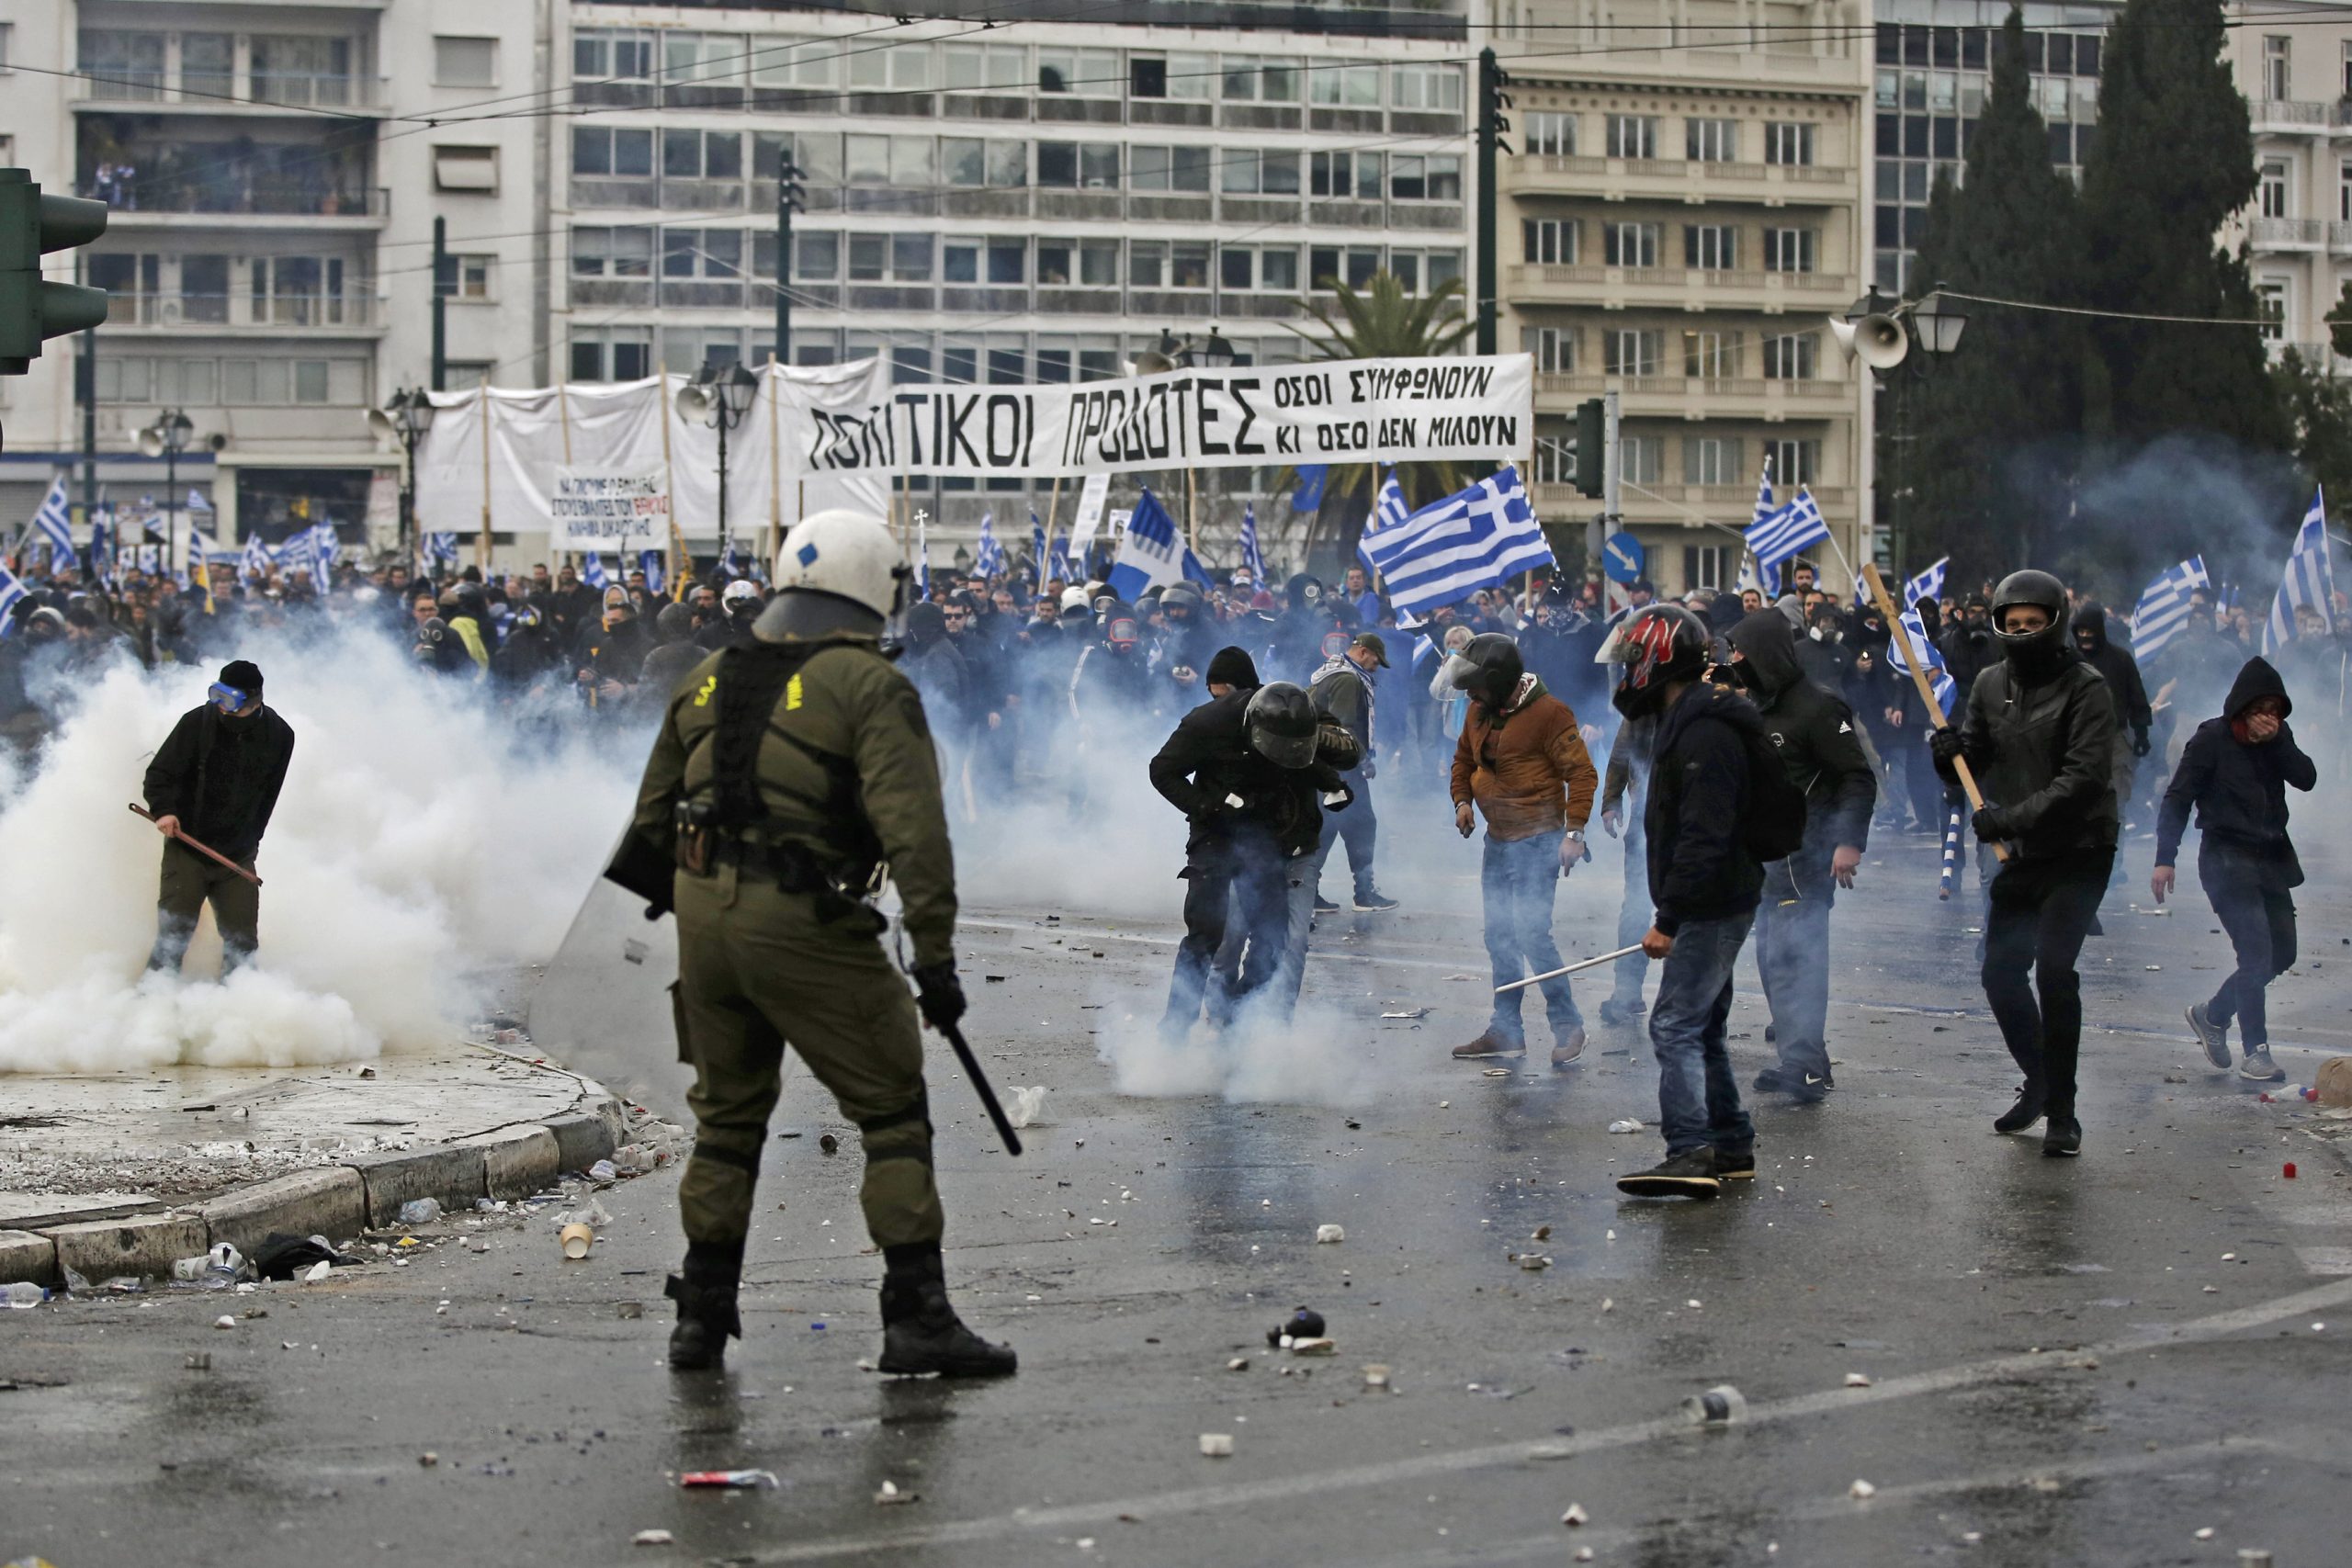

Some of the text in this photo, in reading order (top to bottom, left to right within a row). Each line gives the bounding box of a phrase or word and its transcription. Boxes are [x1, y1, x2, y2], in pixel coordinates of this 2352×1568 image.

[1274, 366, 1494, 408] ΟΣΟΙ ΣΥΜΦΩΝΟΥΝ
[1062, 378, 1266, 467] ΠΡΟΔΟΤΕΣ
[1275, 424, 1302, 454] ΚΙ
[1377, 418, 1417, 448] ΔΕΝ
[1427, 415, 1517, 447] ΜΙΛΟΥΝ
